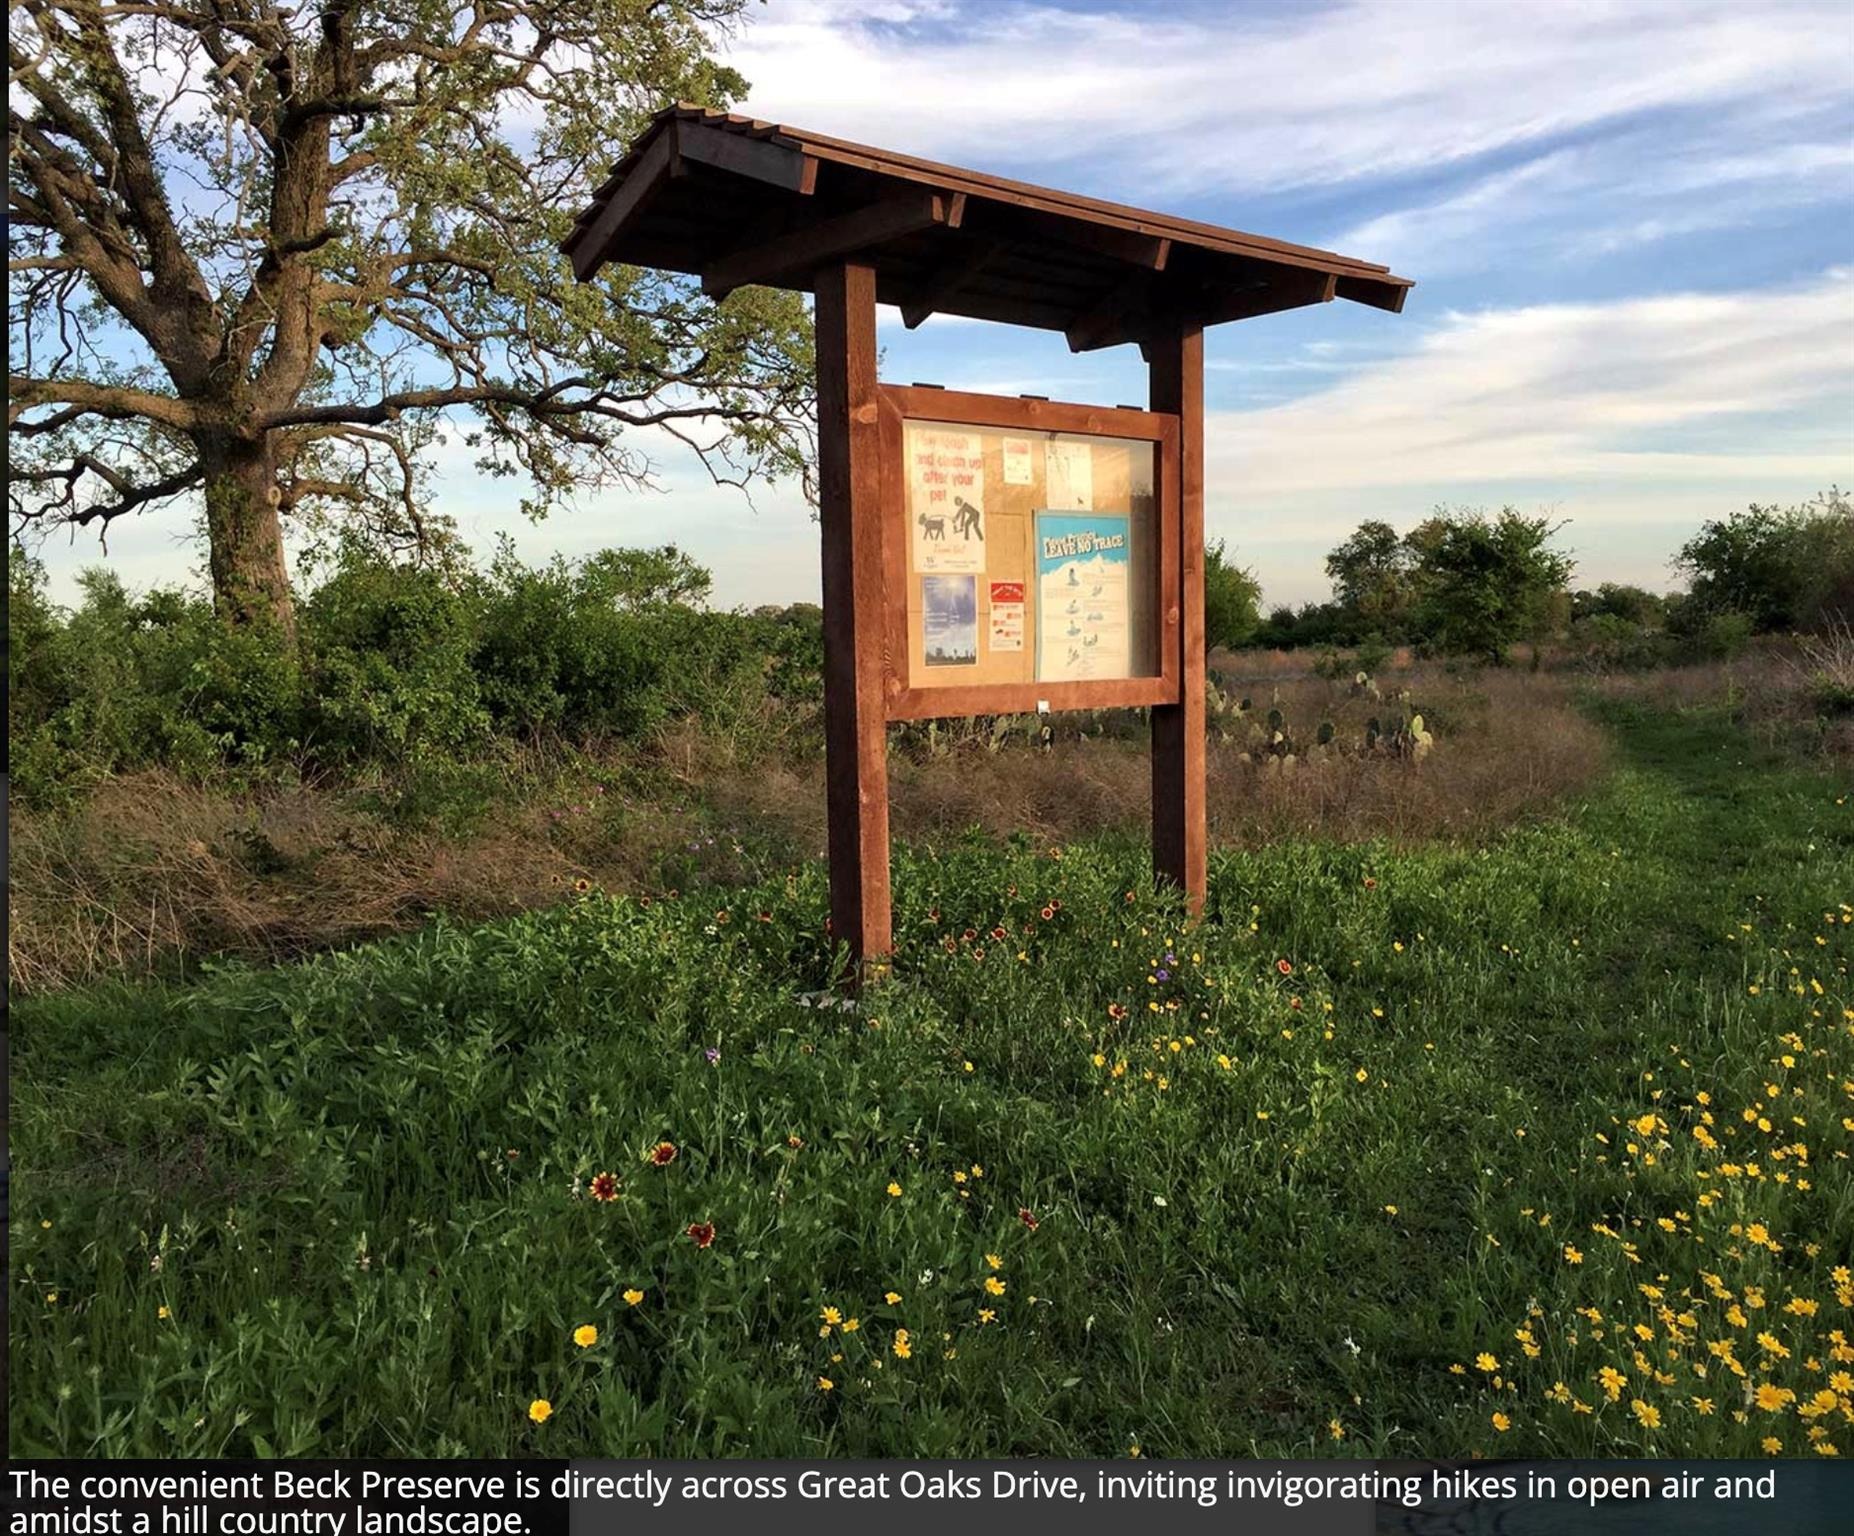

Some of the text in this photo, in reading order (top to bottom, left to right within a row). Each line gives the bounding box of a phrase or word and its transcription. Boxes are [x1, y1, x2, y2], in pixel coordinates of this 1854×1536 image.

[1043, 537, 1077, 559] LEAVE
[1077, 538, 1093, 554] NO
[1093, 533, 1124, 552] TRACE
